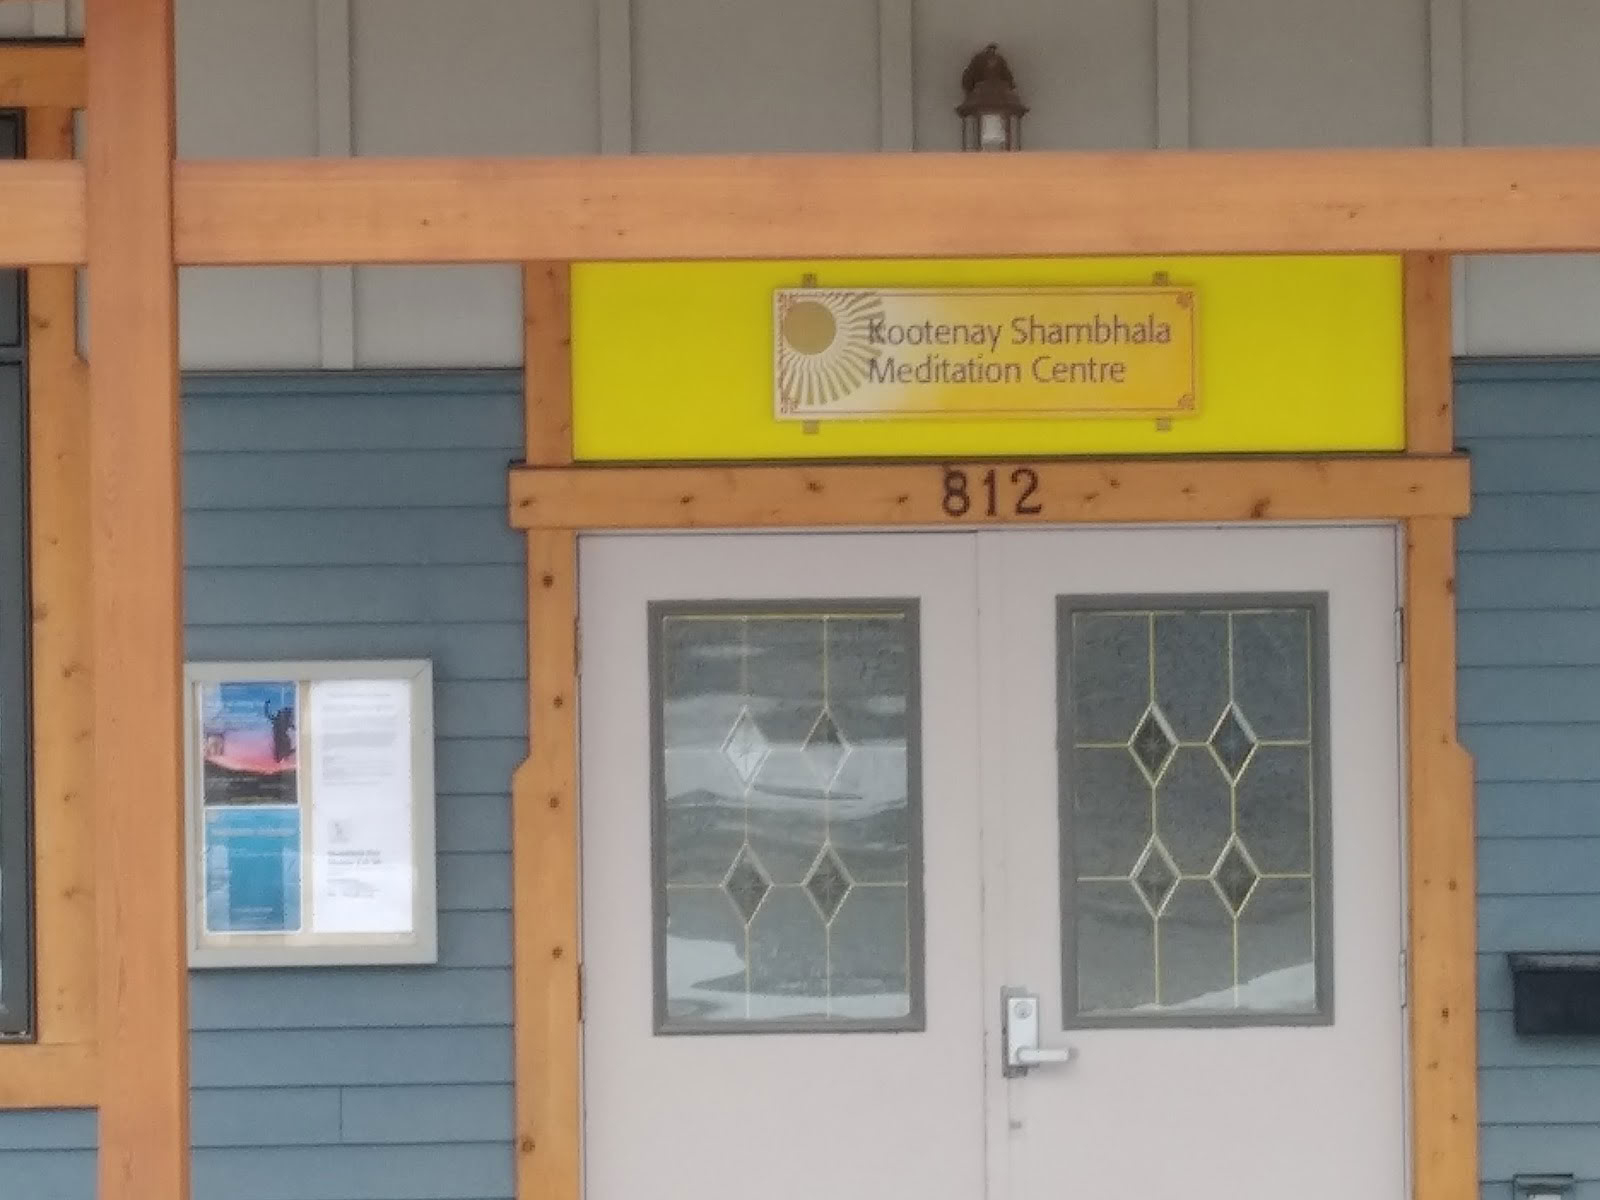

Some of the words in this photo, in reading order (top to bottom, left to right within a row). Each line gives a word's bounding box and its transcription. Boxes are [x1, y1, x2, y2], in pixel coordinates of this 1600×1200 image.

[868, 318, 1002, 353] Kootenay
[1011, 313, 1171, 345] Shambhala
[869, 353, 1021, 383] Meditation
[1032, 355, 1126, 383] Centre
[942, 468, 1042, 517] 812
